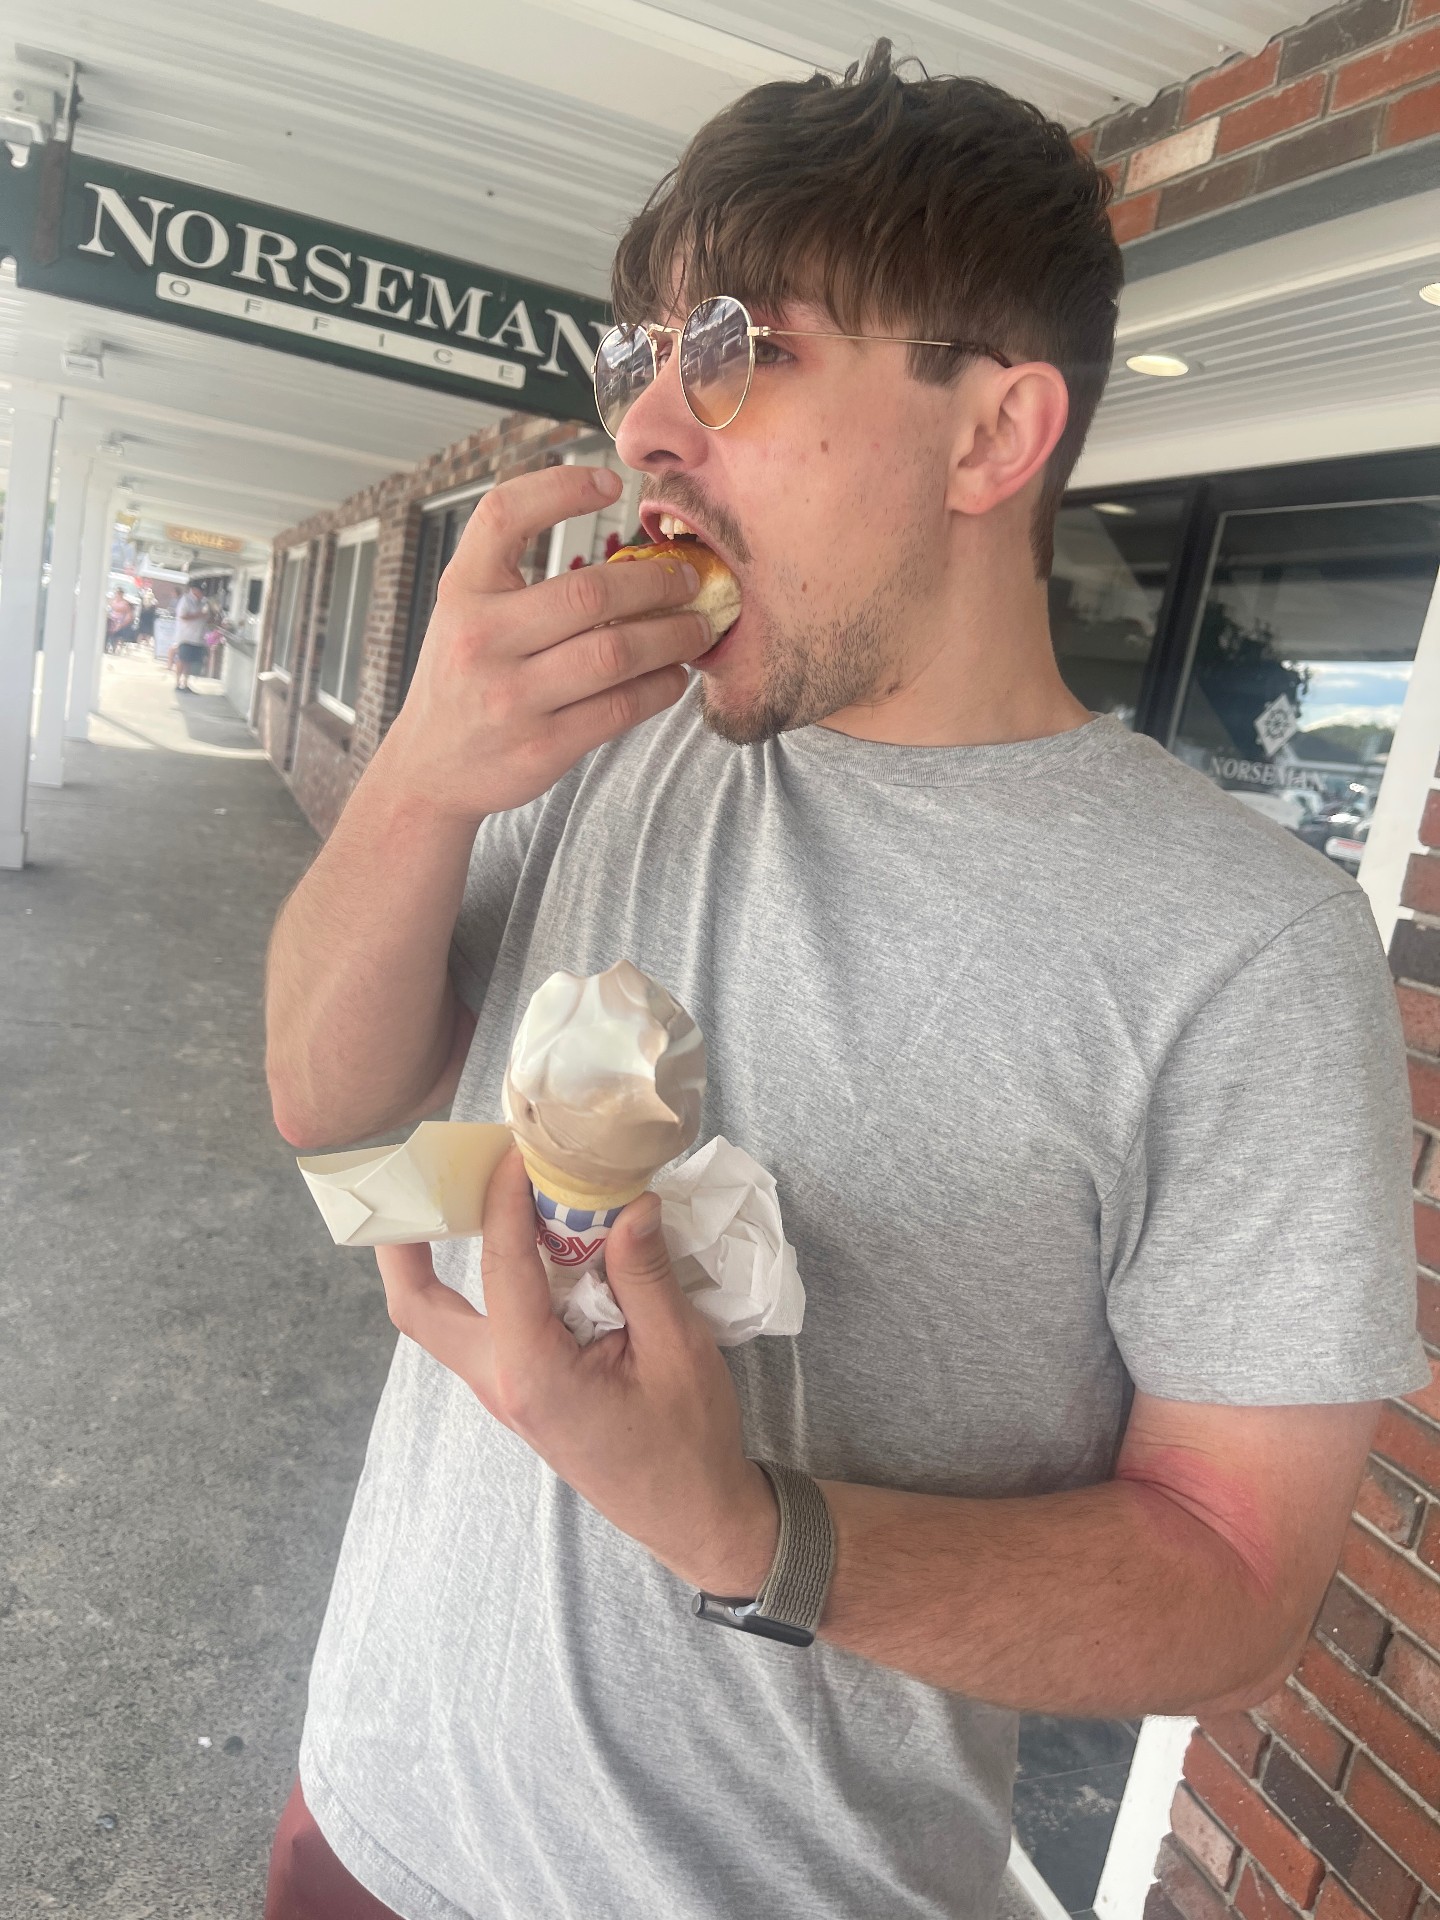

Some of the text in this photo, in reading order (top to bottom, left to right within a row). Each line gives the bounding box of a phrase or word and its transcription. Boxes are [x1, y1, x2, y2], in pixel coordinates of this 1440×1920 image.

[78, 182, 613, 384] NORSEMAN
[168, 280, 517, 382] OFFICE
[1209, 756, 1327, 792] NORSEMAN
